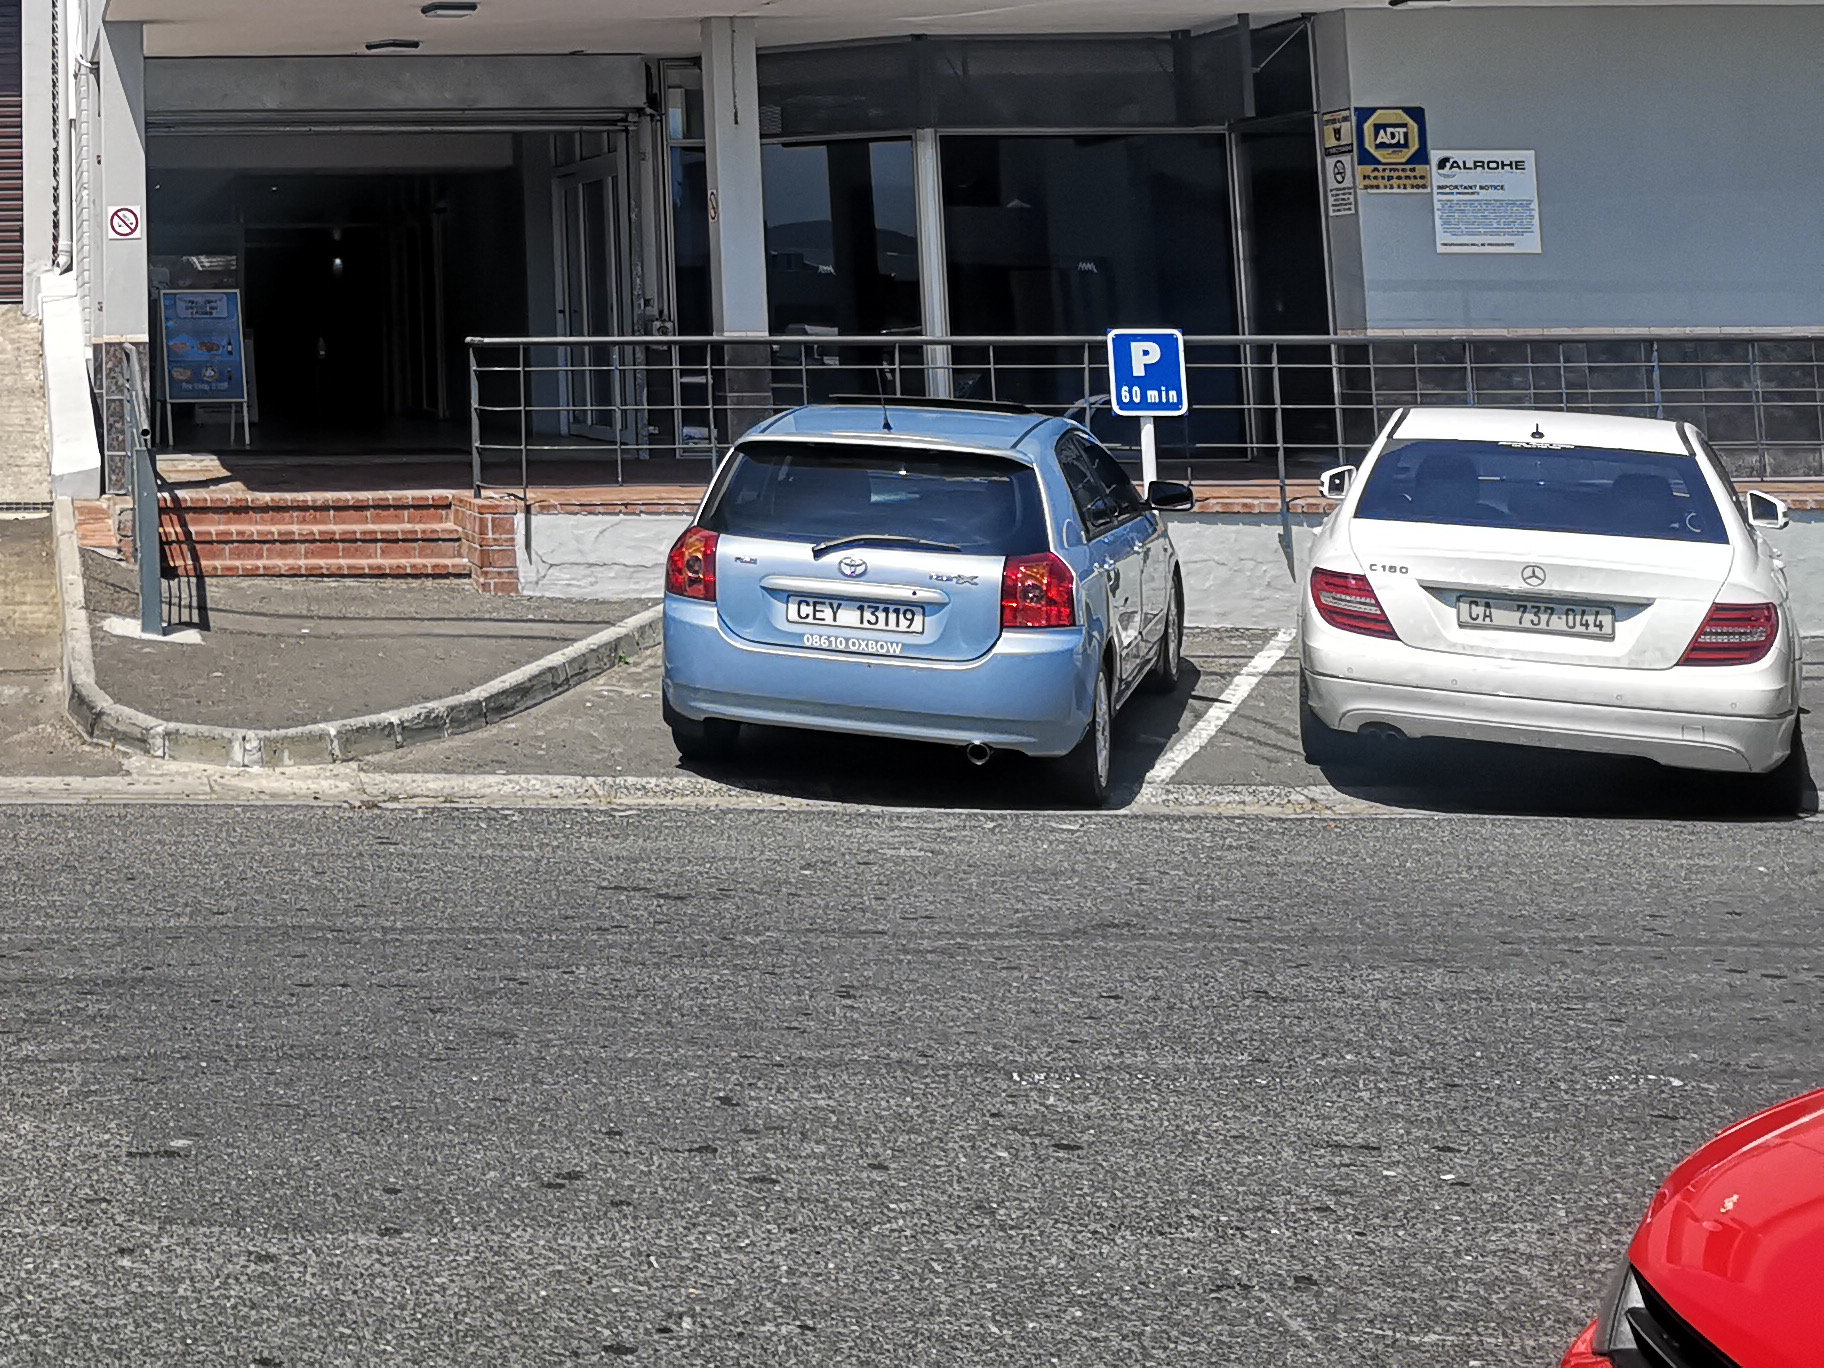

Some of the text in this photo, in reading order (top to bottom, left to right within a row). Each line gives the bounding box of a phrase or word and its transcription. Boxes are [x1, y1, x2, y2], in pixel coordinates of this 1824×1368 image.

[1375, 126, 1408, 144] ADT
[1449, 160, 1526, 171] ALROHE
[1363, 174, 1426, 182] Response
[1130, 341, 1161, 377] P
[1121, 385, 1178, 403] 60 min
[797, 600, 917, 630] CEY 13119
[1468, 600, 1605, 633] CA 737-044
[803, 634, 902, 655] 08610 OXBOW
